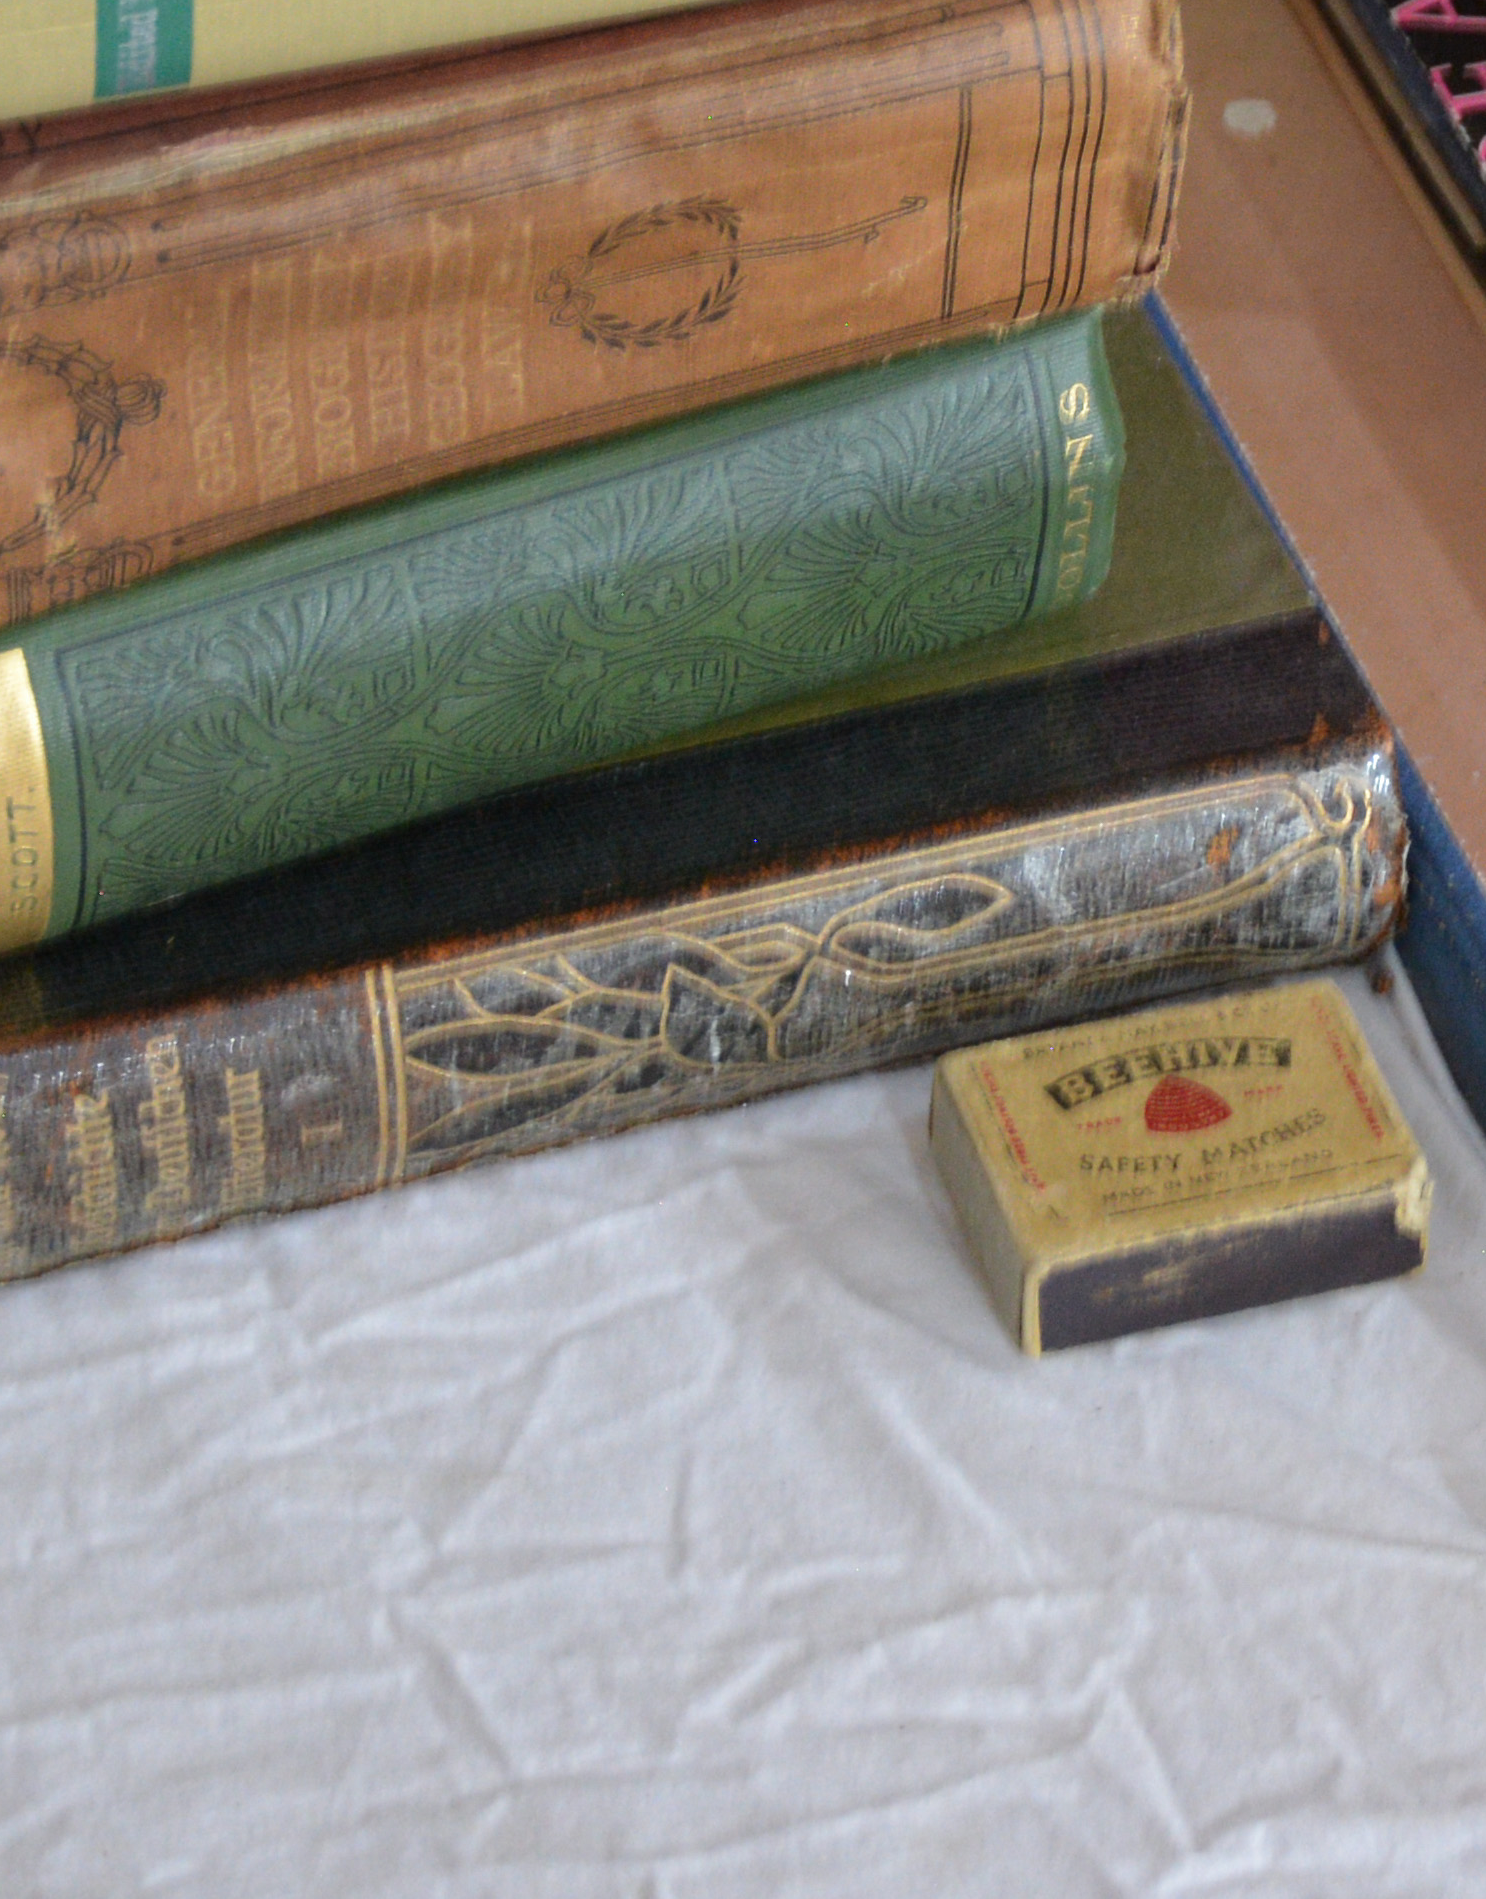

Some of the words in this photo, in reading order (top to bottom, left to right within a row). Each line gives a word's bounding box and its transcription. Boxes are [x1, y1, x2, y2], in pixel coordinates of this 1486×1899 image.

[1058, 381, 1096, 597] OLLINS
[1054, 1037, 1286, 1105] BEEHIVE
[1079, 1152, 1182, 1177] SAFETY
[1200, 1107, 1328, 1170] MATCHES
[1101, 1185, 1156, 1205] MADE
[1163, 1177, 1184, 1192] IN
